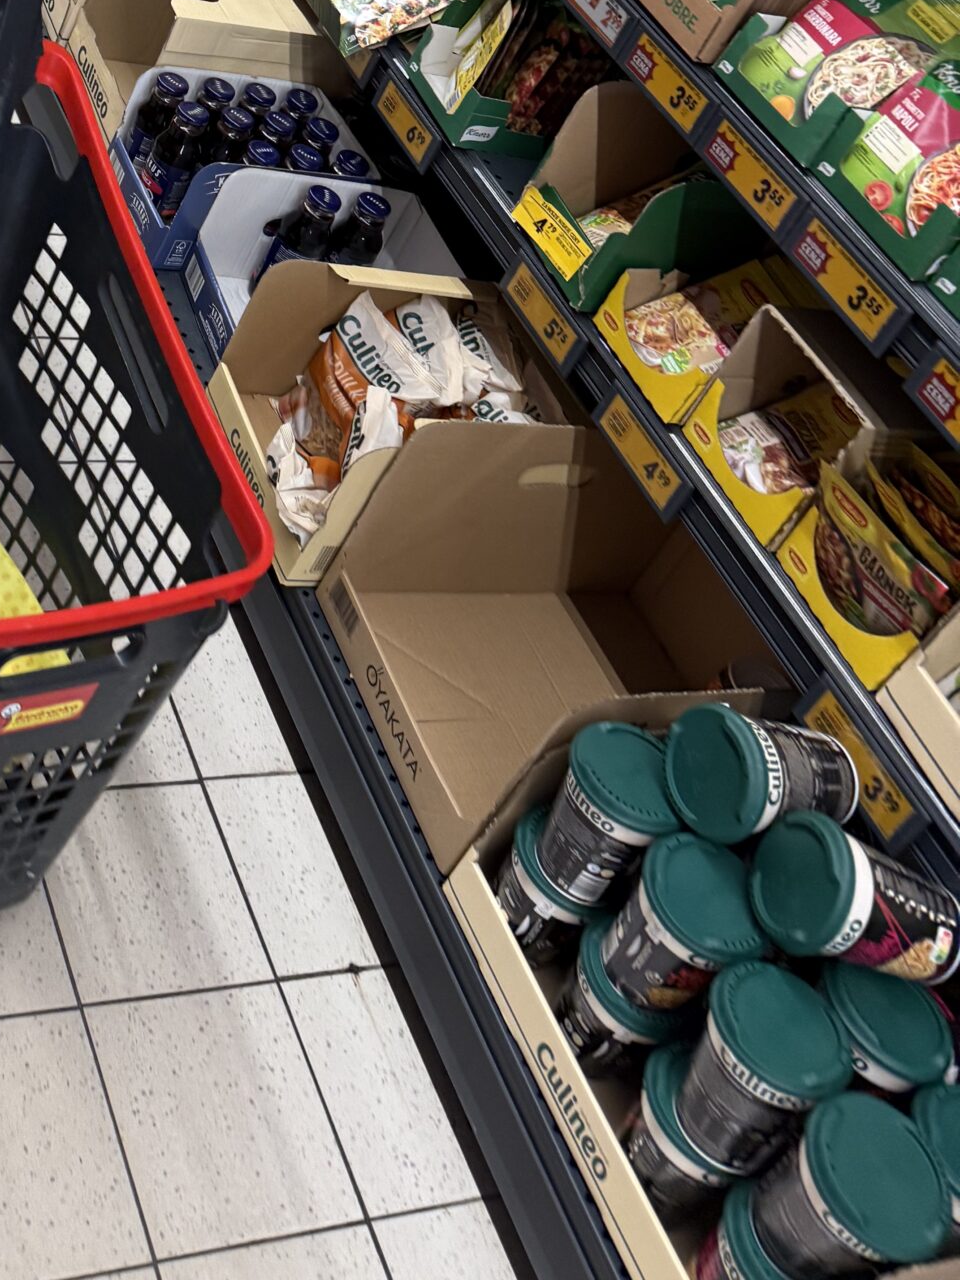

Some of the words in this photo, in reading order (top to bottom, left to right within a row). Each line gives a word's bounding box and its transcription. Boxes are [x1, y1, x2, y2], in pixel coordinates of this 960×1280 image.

[599, 9, 624, 30] 299
[803, 8, 843, 47] CARBONARA
[631, 54, 651, 76] CENA
[933, 63, 960, 95] Kno
[77, 45, 109, 119] Culineo
[669, 85, 698, 111] 355
[891, 103, 920, 133] NAPOLI
[710, 143, 731, 166] CENA
[752, 178, 785, 208] 355
[532, 218, 557, 236] 479
[799, 242, 823, 269] CENA
[846, 285, 884, 316] 355
[543, 318, 568, 345] 575
[339, 314, 402, 394] Culineo
[924, 382, 952, 412] CENA
[228, 427, 267, 509] Culineo
[642, 461, 672, 489] 499
[858, 546, 918, 618] GARNEK
[366, 664, 419, 783] ÖYAKATA
[566, 772, 616, 833] ulineo
[863, 775, 901, 814] 399
[536, 1040, 608, 1182] Culineo
